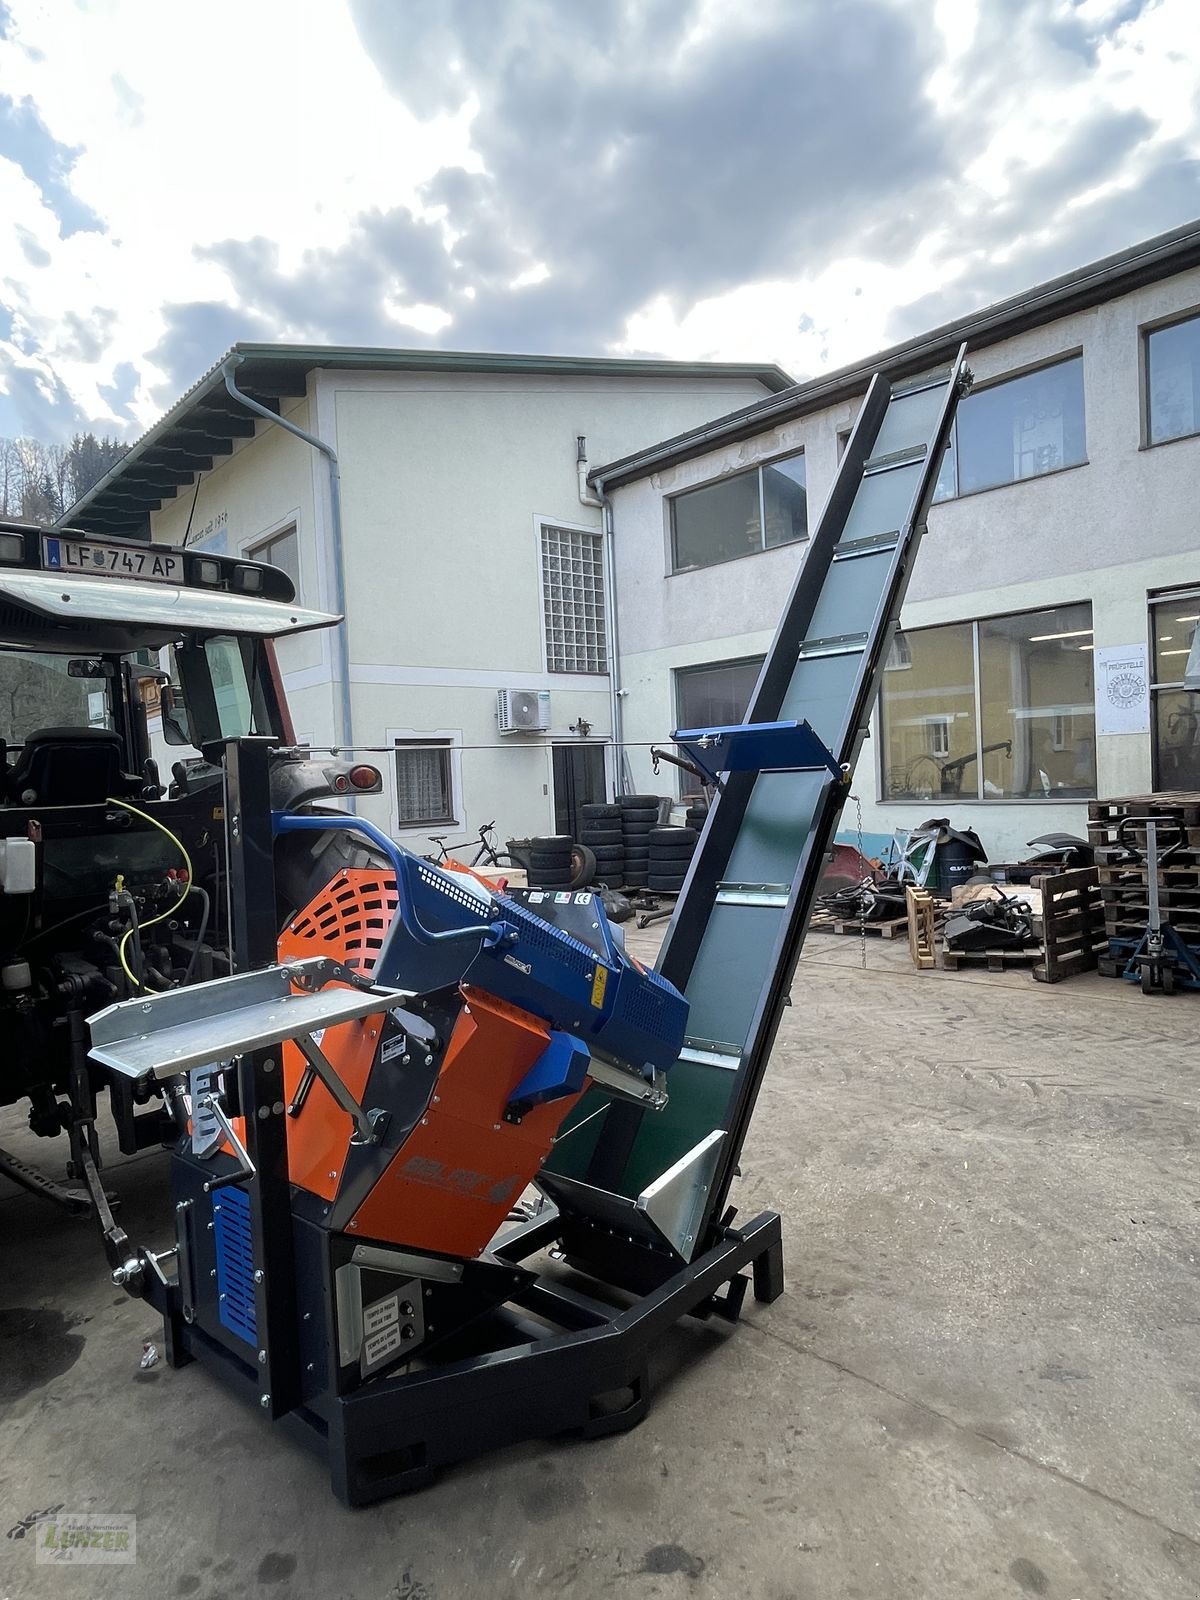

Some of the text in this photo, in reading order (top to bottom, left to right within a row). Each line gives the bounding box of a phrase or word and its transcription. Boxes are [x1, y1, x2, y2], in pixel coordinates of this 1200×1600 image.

[66, 544, 176, 577] LF 747 AP
